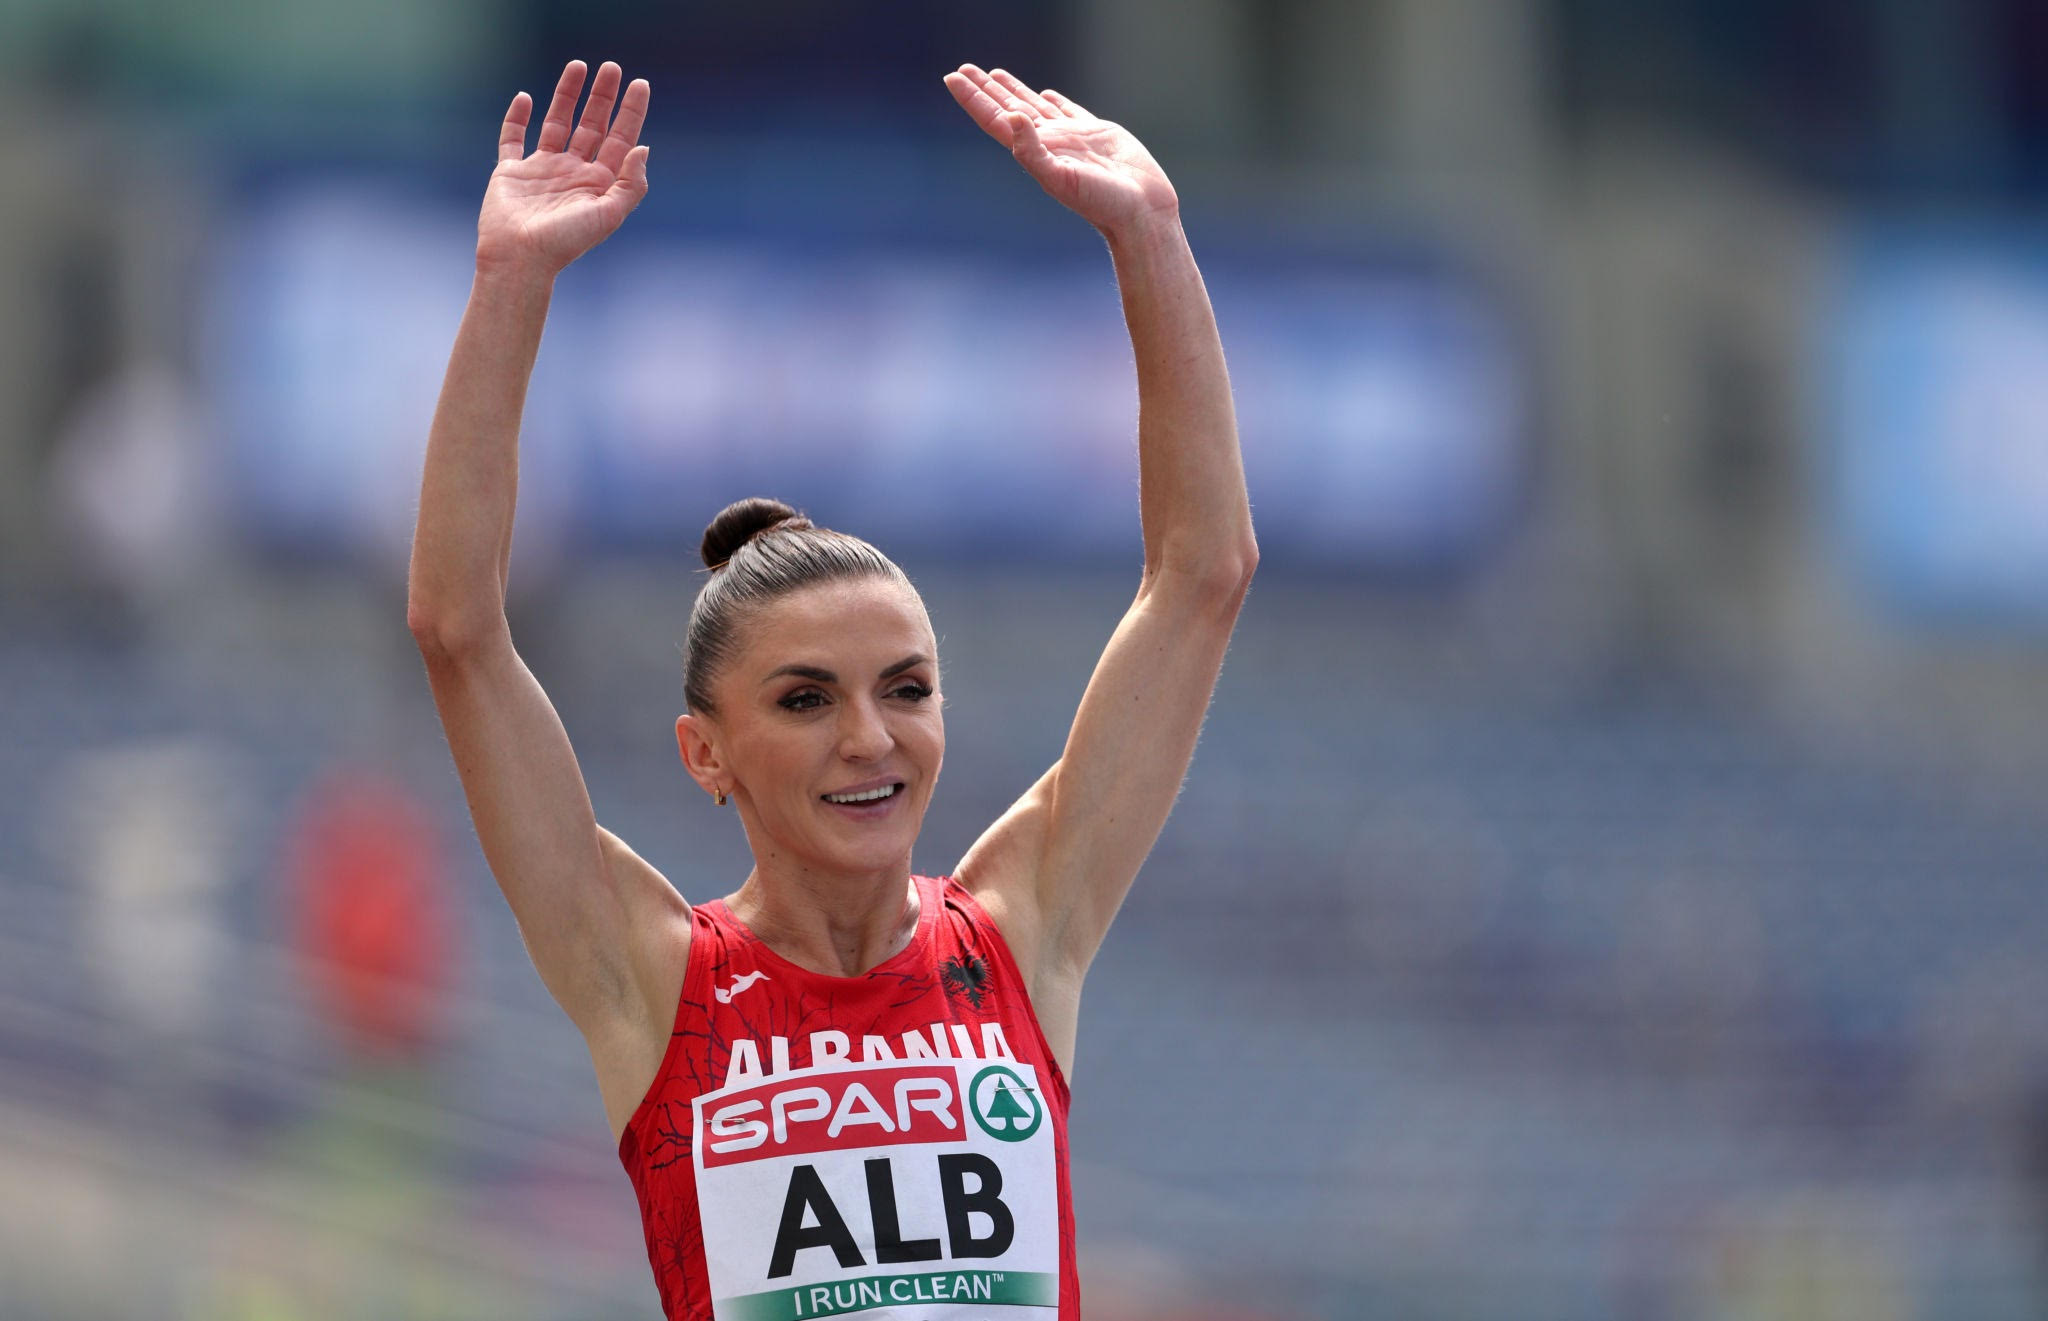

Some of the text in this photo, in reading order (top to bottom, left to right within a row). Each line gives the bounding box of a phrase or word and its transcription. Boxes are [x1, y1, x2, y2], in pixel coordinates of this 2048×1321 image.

[710, 1077, 958, 1154] SPAR
[767, 1153, 1015, 1280] ALB
[794, 1290, 803, 1316] I
[811, 1280, 882, 1313] RUN
